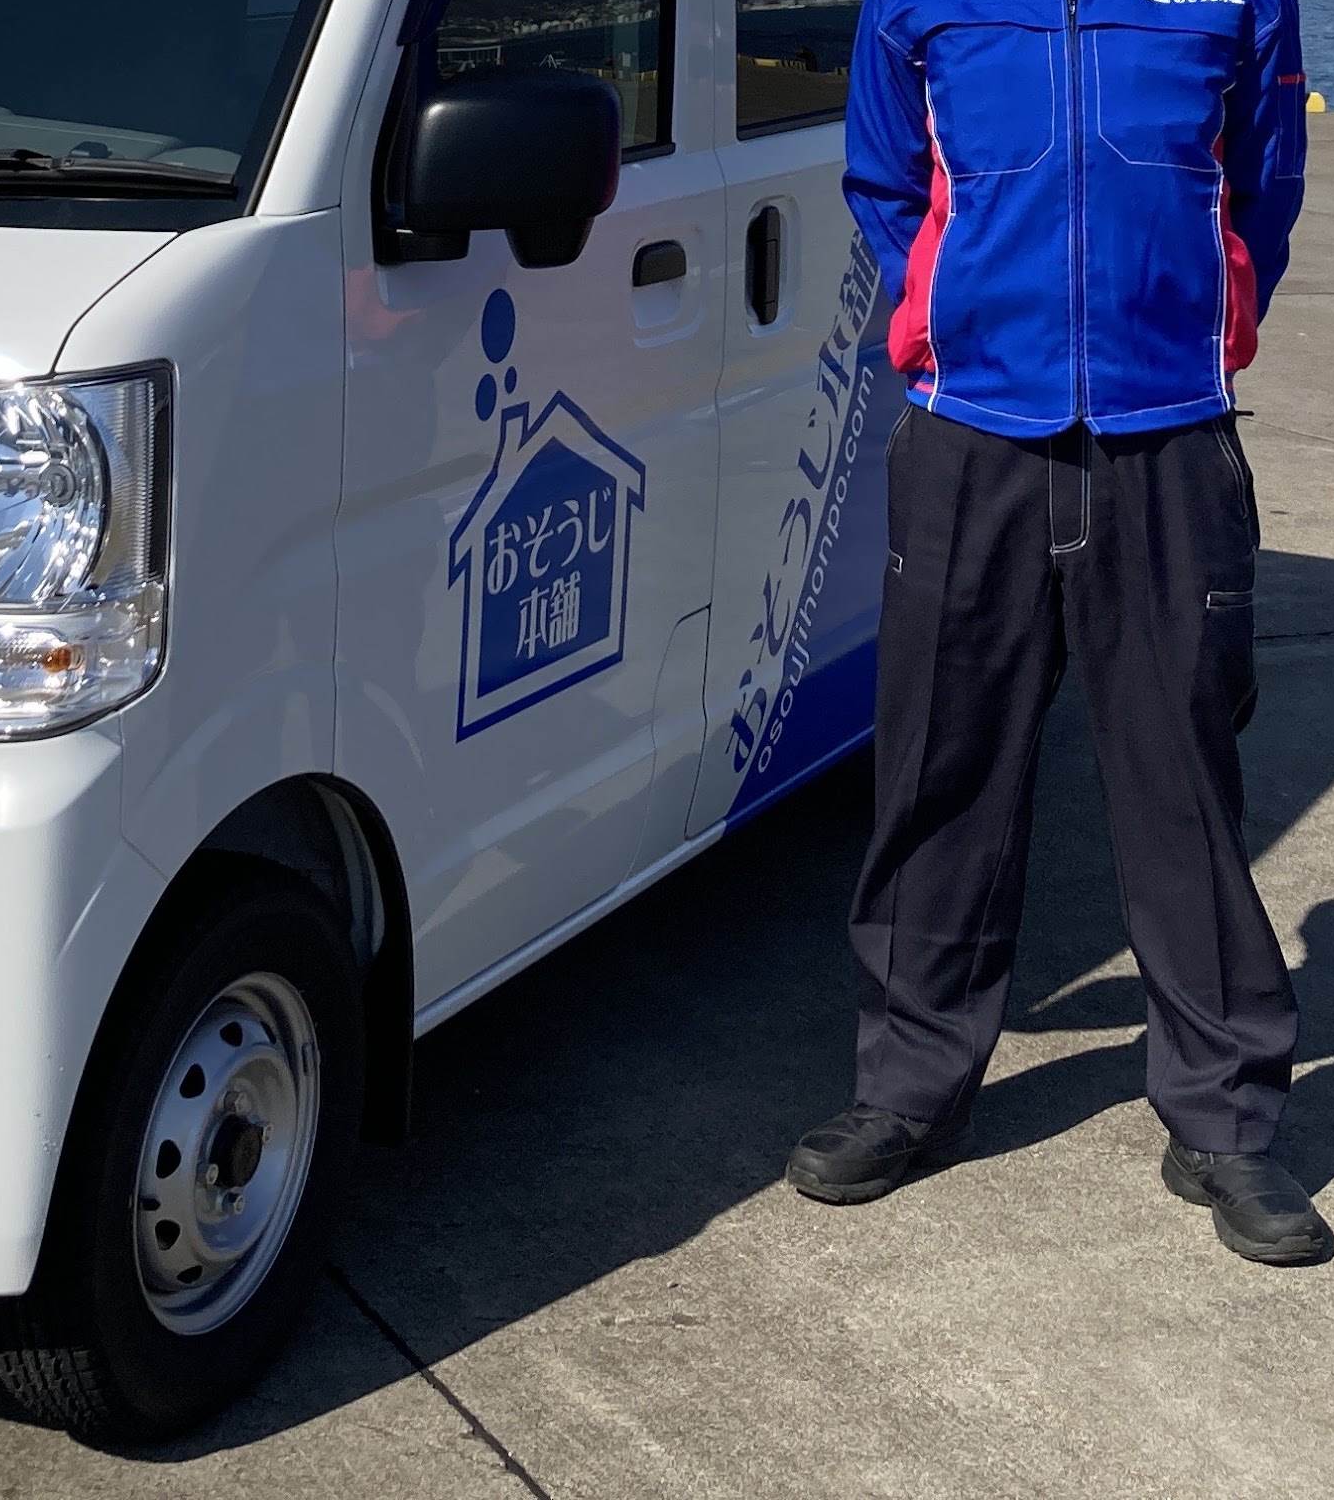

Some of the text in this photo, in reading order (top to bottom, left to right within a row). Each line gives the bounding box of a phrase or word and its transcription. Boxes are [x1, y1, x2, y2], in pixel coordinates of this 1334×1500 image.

[487, 485, 613, 595] おそうじ
[758, 366, 875, 774] osoujihonpo.com
[516, 570, 582, 660] 本舗
